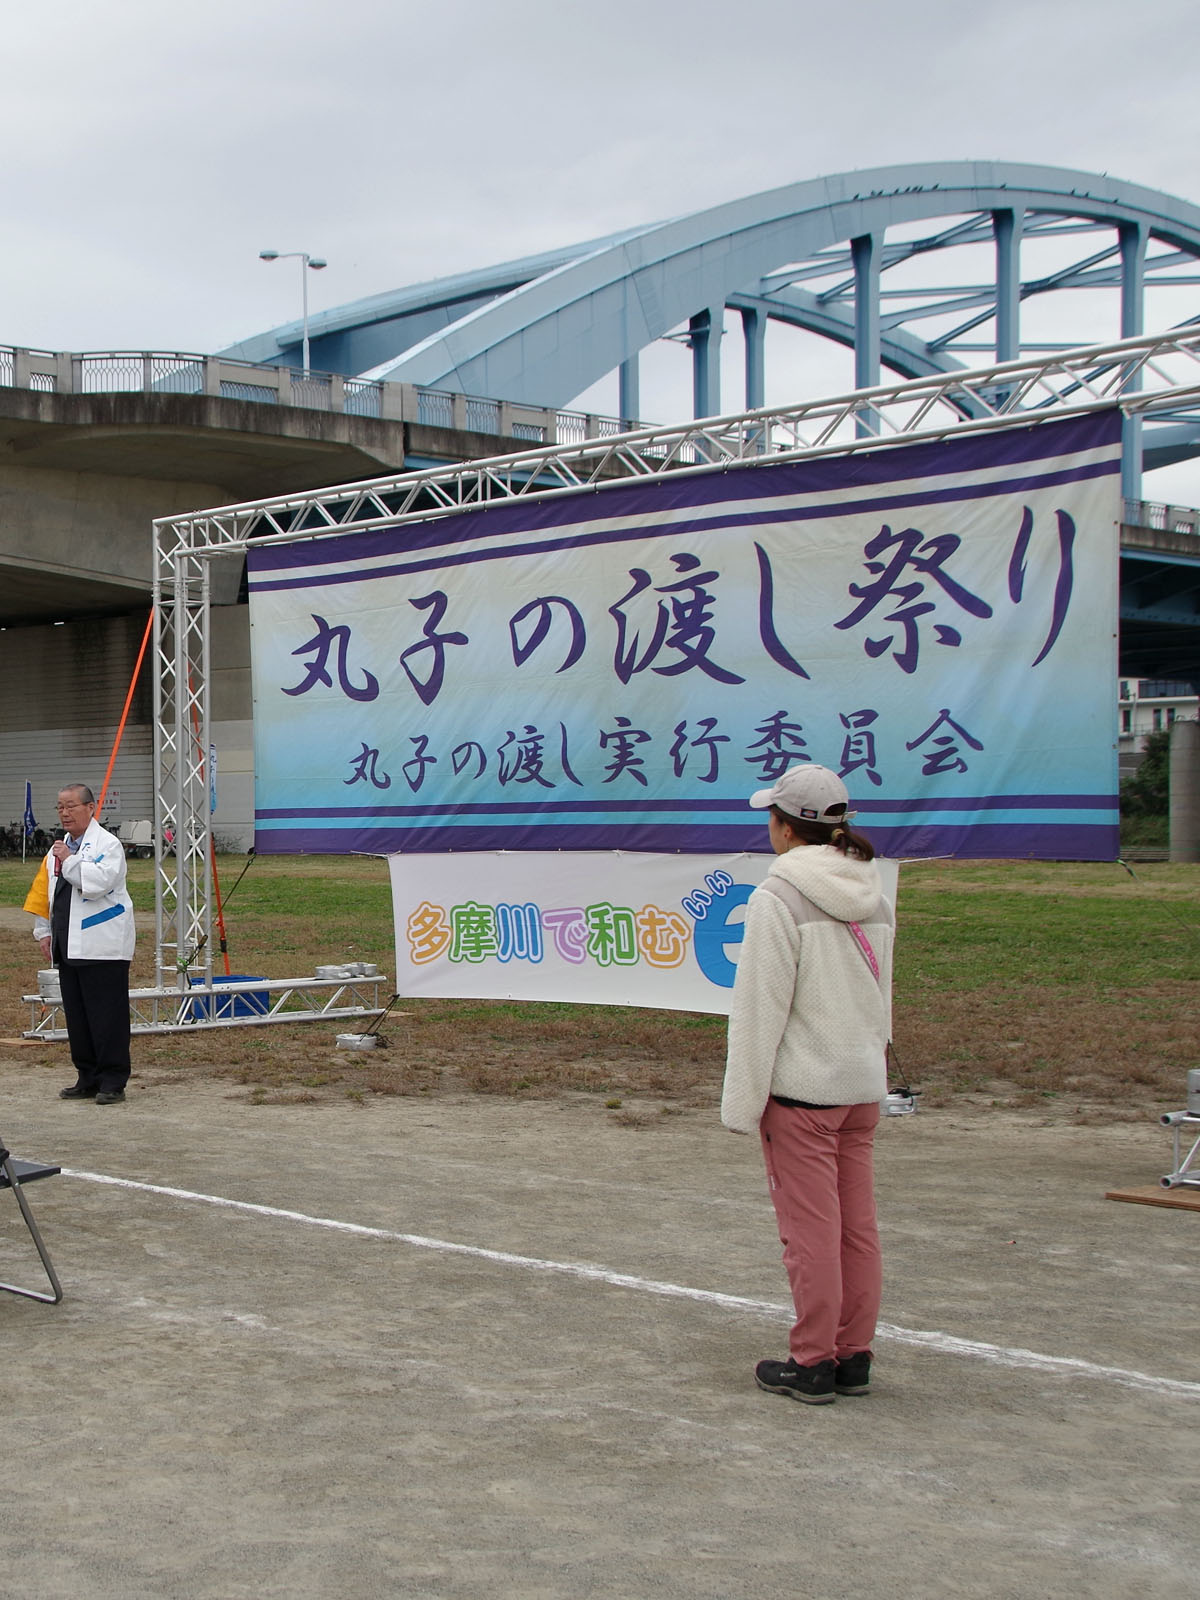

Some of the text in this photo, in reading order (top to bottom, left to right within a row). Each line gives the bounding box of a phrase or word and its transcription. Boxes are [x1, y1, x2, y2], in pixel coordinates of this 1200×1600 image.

[280, 505, 1076, 706] 丸子の渡し祭り
[343, 708, 985, 793] 丸子の渡し実行委員会
[406, 900, 691, 970] 多摩川で和む
